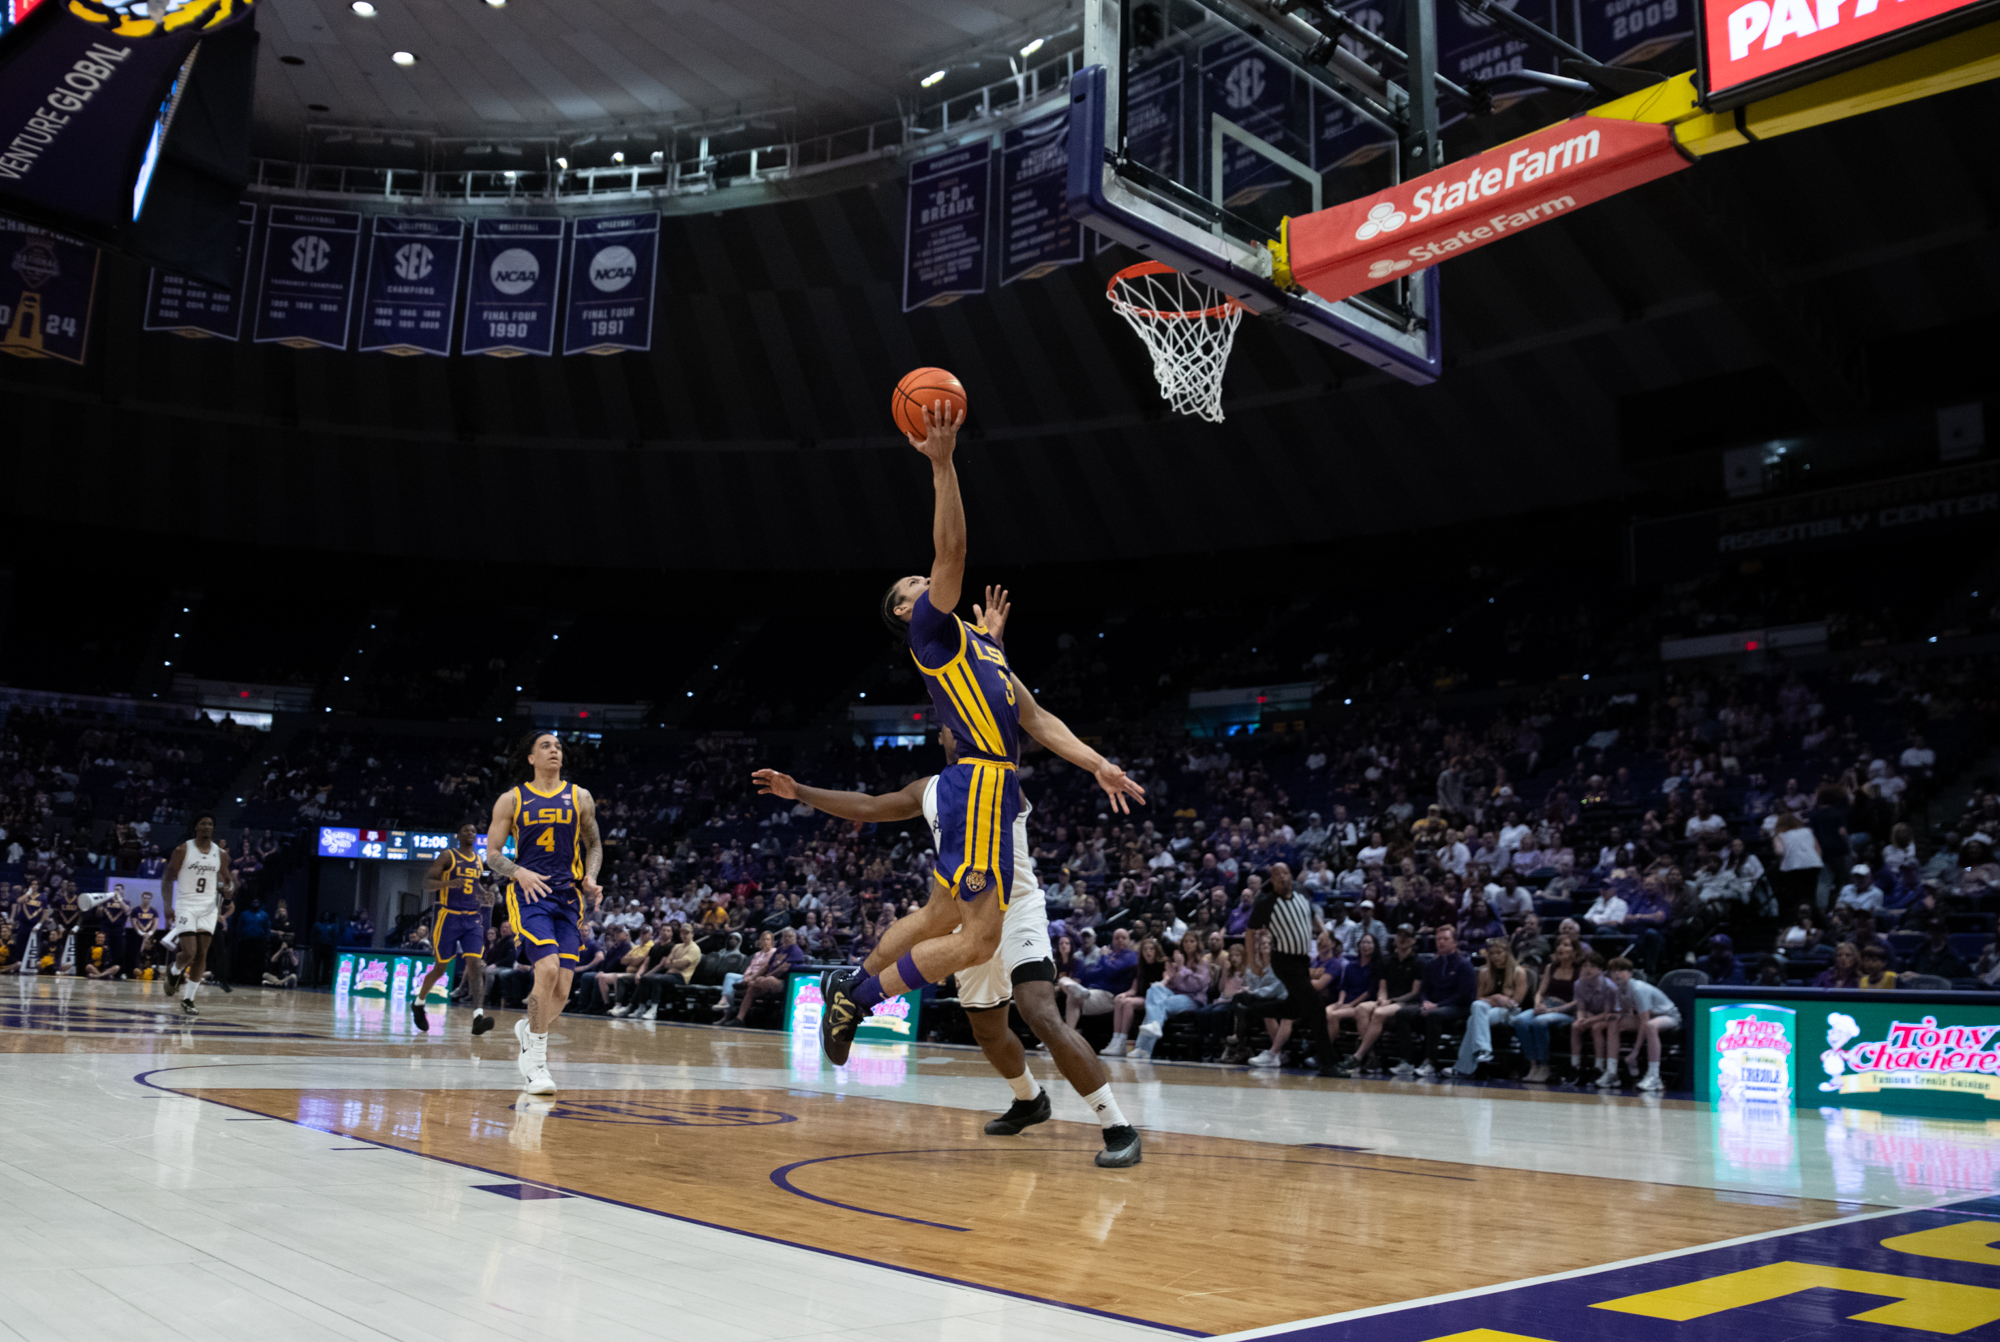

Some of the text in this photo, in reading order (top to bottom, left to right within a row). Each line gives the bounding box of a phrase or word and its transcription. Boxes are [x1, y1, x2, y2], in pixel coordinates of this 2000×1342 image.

[1612, 0, 1678, 41] 2009
[1225, 57, 1267, 109] SEC
[0, 106, 70, 180] VENTURE
[47, 42, 132, 112] GLOBAL
[920, 195, 975, 225] BREAUX
[291, 235, 331, 273] SEC
[394, 243, 434, 281] SEC
[495, 271, 536, 283] NCAA
[594, 267, 634, 281] NCAA
[387, 285, 435, 296] CHAMPIONS
[483, 311, 537, 321] FINAL FOUR
[582, 307, 635, 320] FINAL FOUR
[45, 314, 77, 338] 24
[489, 322, 528, 338] 1990
[591, 320, 624, 336] 1991
[1717, 491, 2000, 552] ASSEMBLY CENTER
[997, 669, 1016, 706] 3
[523, 808, 573, 826] LSU
[394, 837, 402, 847] 2
[413, 835, 448, 849] 12:06
[536, 826, 555, 852] 4
[362, 843, 382, 857] 42
[188, 861, 217, 876] Aggies
[456, 866, 481, 879] LSU
[195, 877, 207, 893] 9
[463, 878, 474, 895] 5
[1735, 1016, 1785, 1038] Tony
[1892, 1018, 1996, 1050] Tony
[1872, 1073, 1991, 1091] Famous Creole Cuisine
